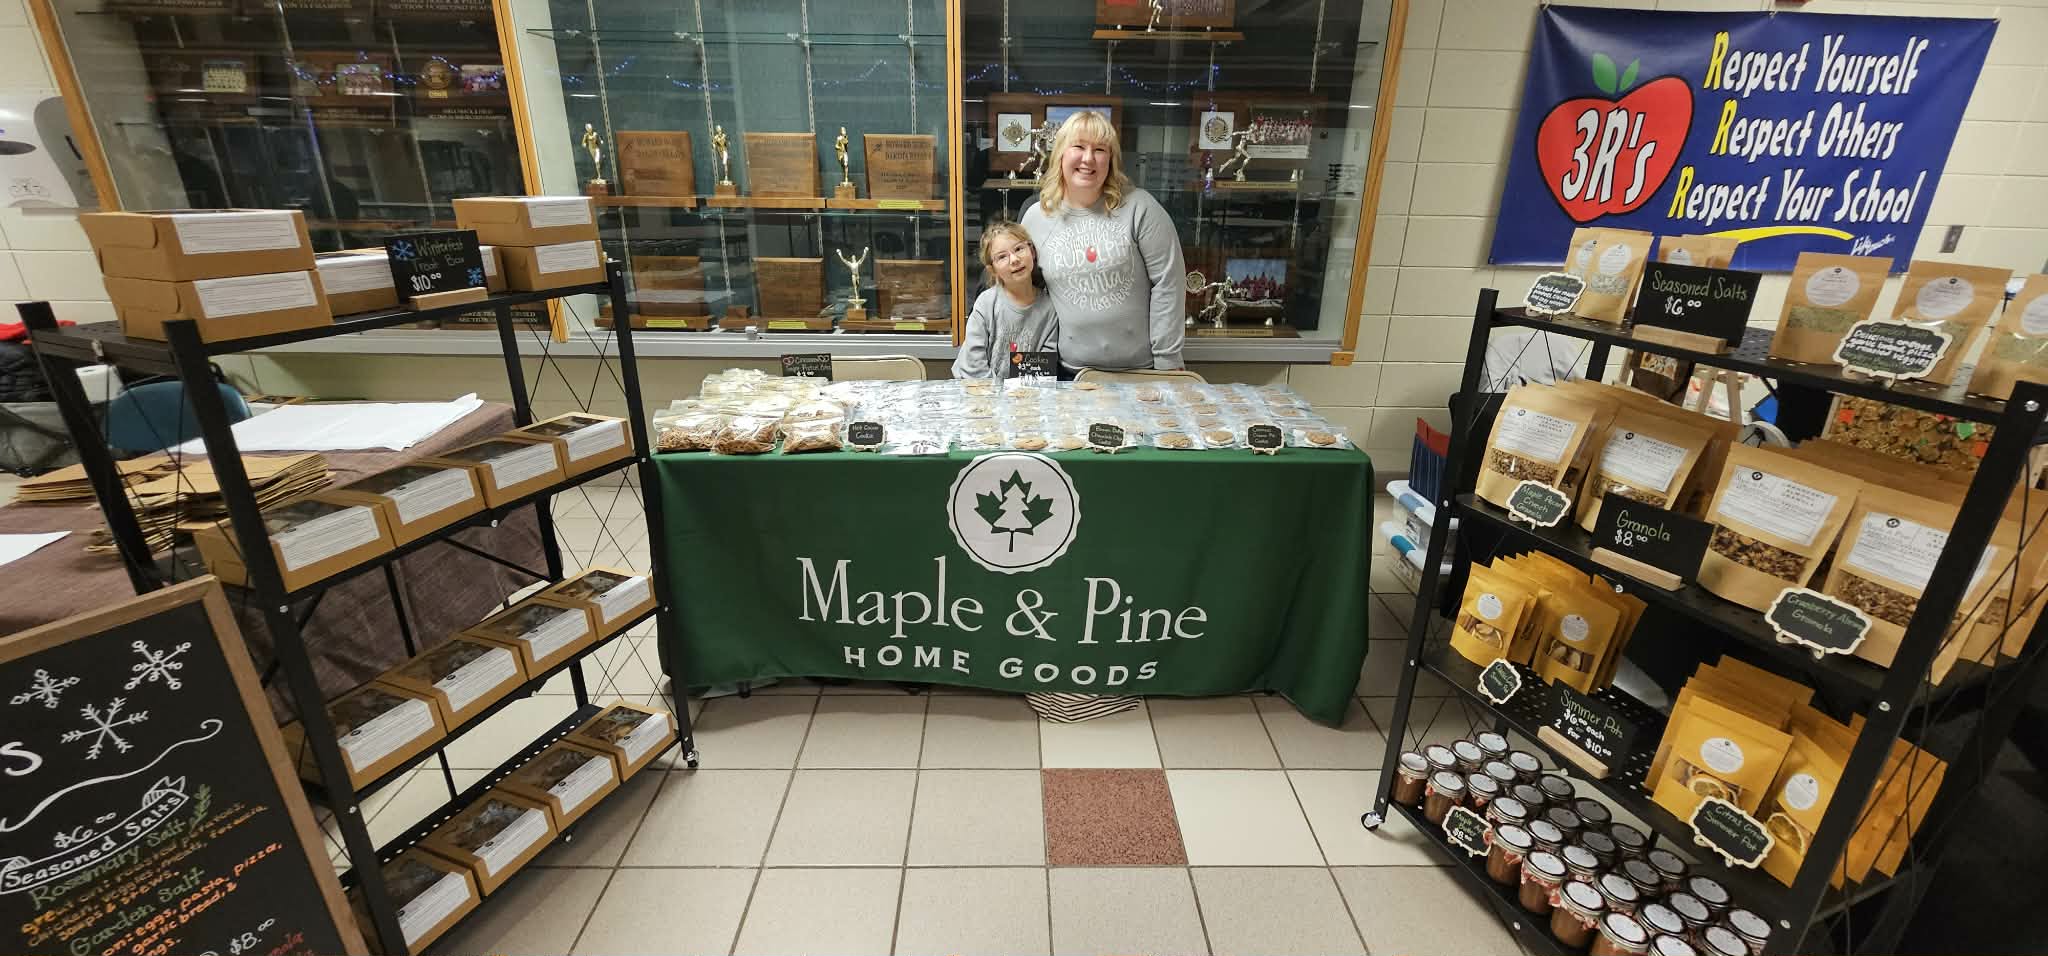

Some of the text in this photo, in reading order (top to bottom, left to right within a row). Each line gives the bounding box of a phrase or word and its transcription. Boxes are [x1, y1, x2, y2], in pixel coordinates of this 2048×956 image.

[1703, 31, 1929, 98] Respect Yourself
[1709, 99, 1903, 163] Respect Others
[1560, 107, 1657, 206] 3R's
[1667, 166, 1927, 226] Respect Your School
[1652, 270, 1748, 301] Seasoned Salts
[1614, 530, 1649, 548] $8.00
[1616, 509, 1671, 542] Granola
[796, 555, 1208, 645] Maple & Pine
[844, 645, 1160, 686] HOME GOODS
[1561, 689, 1623, 739] Simmer Pots
[1586, 725, 1605, 742] each
[1554, 718, 1612, 757] 2 for $10.00
[4, 796, 181, 888] Seasoned Salts
[54, 812, 116, 848] $6.00
[29, 819, 186, 910] Rosemary Salt
[234, 843, 282, 877] pizza,
[22, 901, 74, 934] great
[70, 866, 205, 956] Garden Salt
[132, 920, 178, 956] garlic
[230, 917, 277, 956] $8.00
